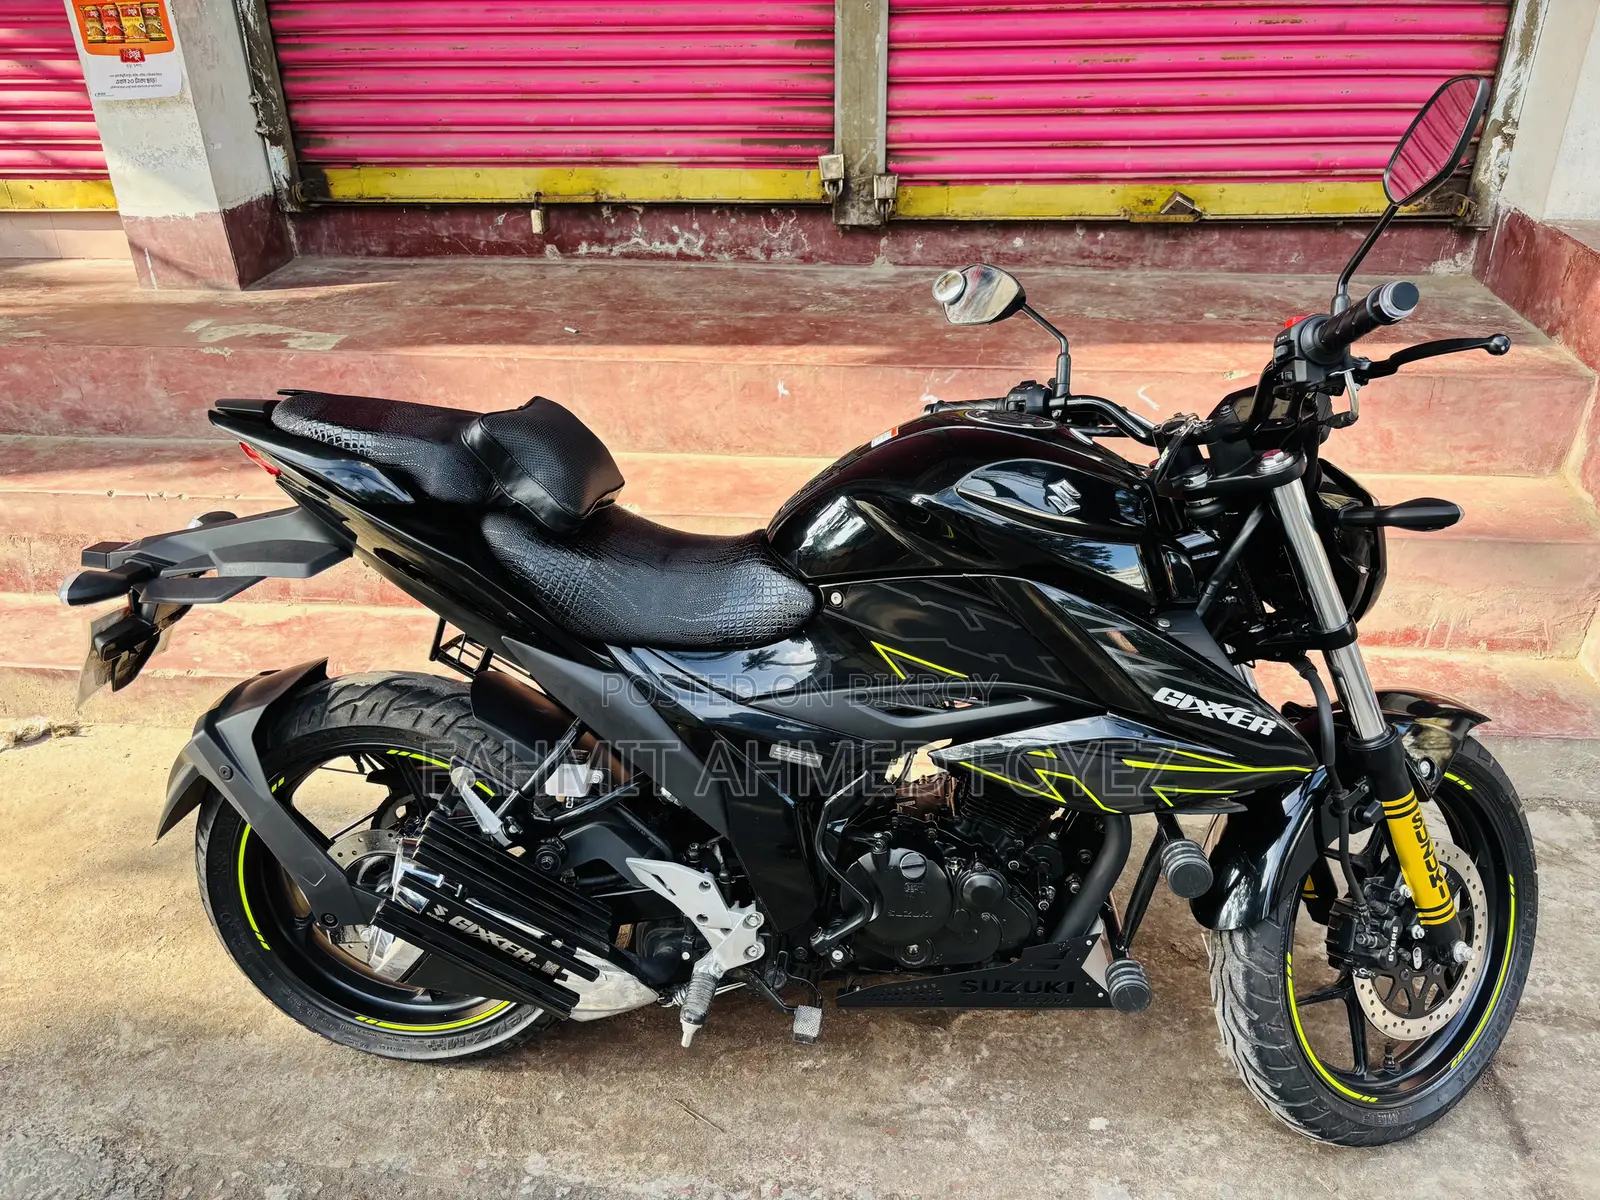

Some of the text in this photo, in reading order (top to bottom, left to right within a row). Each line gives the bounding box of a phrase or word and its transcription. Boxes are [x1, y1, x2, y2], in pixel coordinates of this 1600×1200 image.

[1152, 686, 1278, 737] GIXXER
[1411, 811, 1447, 900] SUZUKI
[448, 915, 537, 964] GIXXER
[957, 978, 1076, 995] SUZUKI
